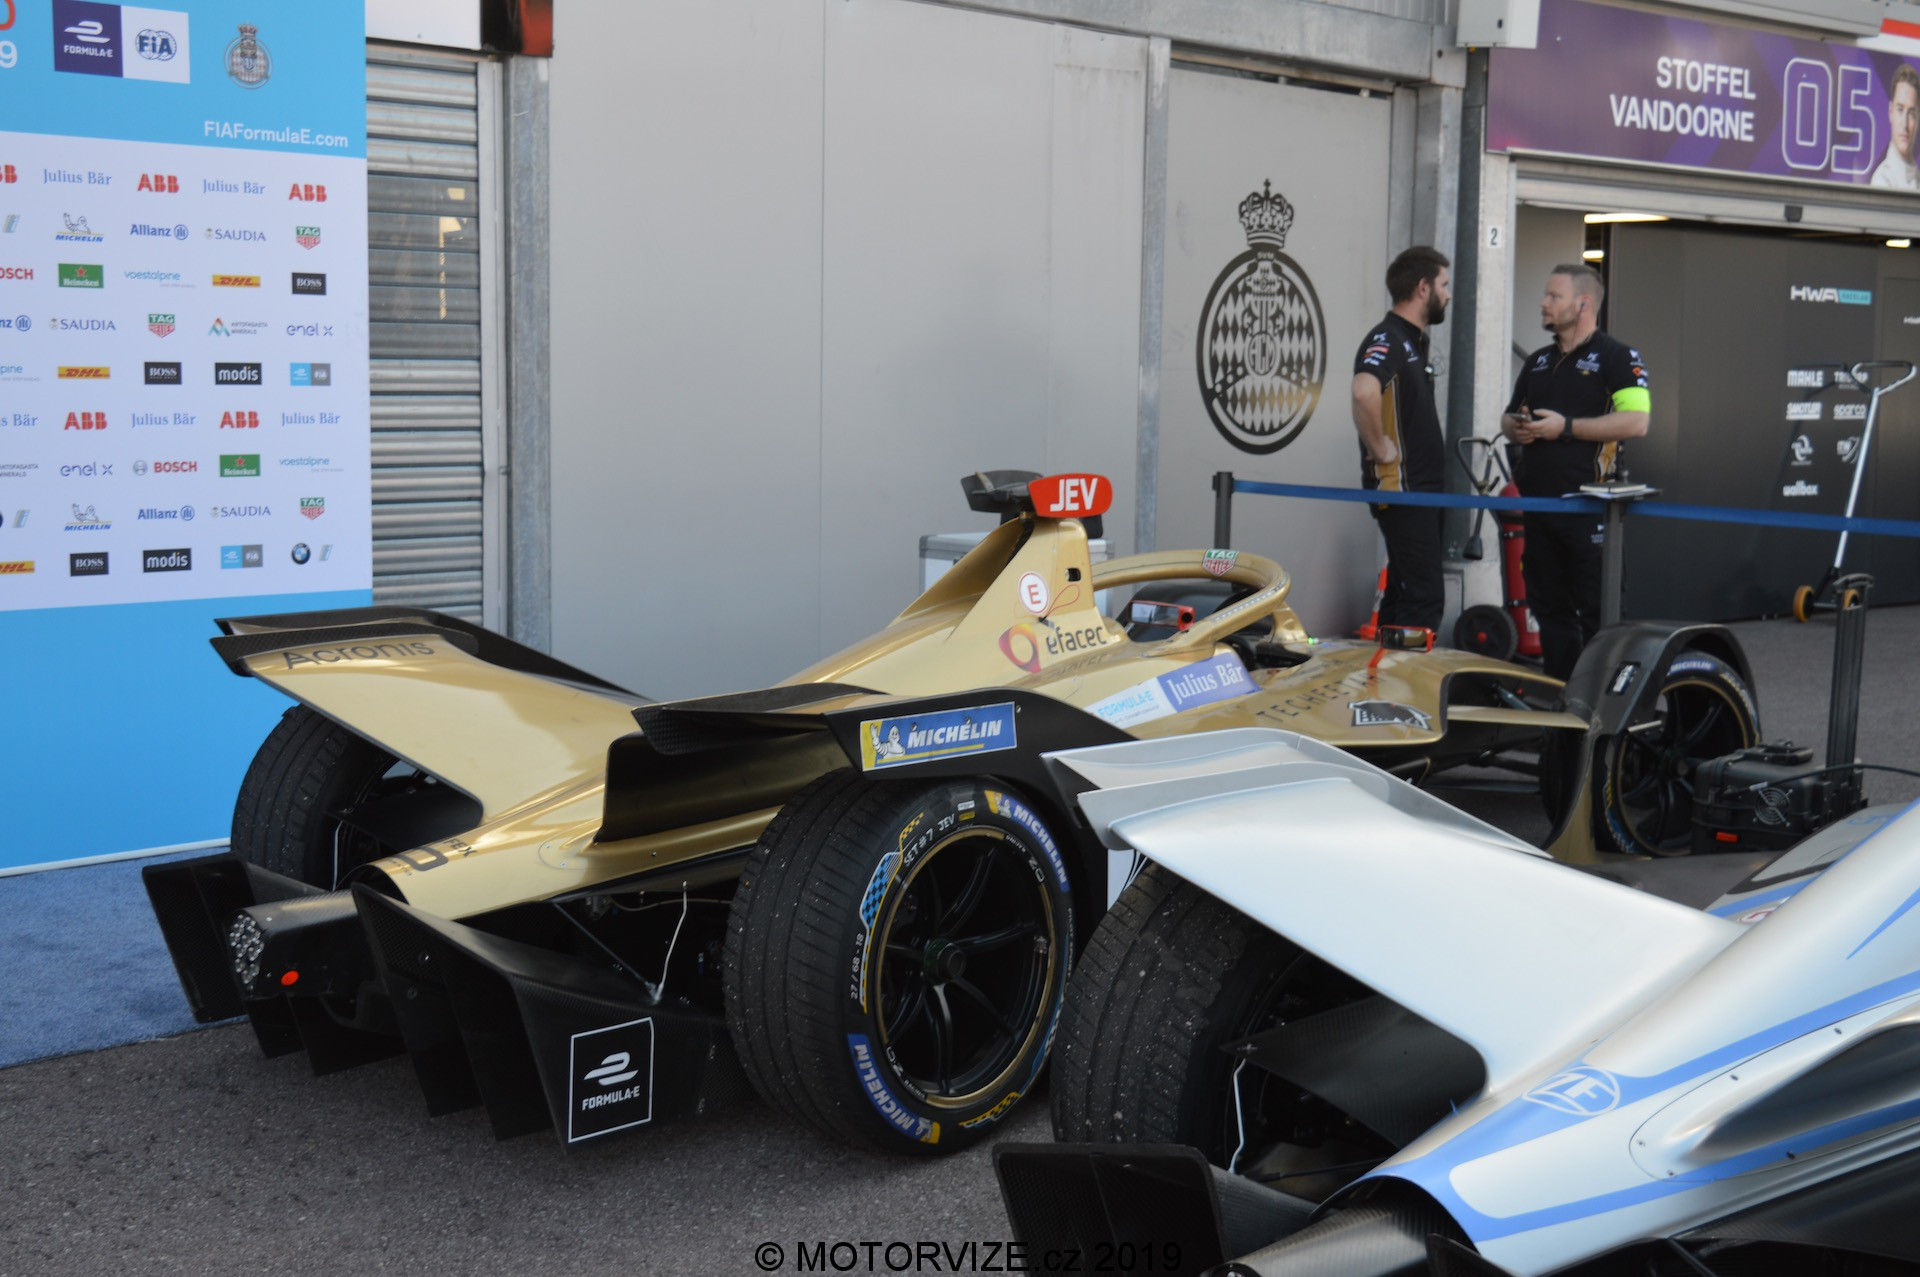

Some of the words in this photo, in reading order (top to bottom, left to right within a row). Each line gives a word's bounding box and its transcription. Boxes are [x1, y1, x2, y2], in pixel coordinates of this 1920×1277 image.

[1656, 56, 1756, 100] STOFFEL
[1609, 94, 1754, 143] VANDOORNE
[1781, 56, 1877, 176] 05
[204, 121, 349, 148] FIAFormulaE.com
[43, 168, 84, 185] Julius
[87, 171, 113, 186] Bär
[138, 173, 180, 194] ABB
[202, 178, 240, 194] Julius
[243, 180, 266, 195] Bär
[289, 183, 328, 203] ABB
[55, 234, 104, 243] MICHELIN
[130, 224, 172, 238] Allianz
[214, 228, 267, 242] SAUDIA
[297, 227, 321, 237] TAG
[1490, 227, 1498, 246] 2
[63, 277, 100, 288] Heineken
[124, 269, 182, 282] voestalpine
[217, 276, 255, 288] DHL
[296, 277, 323, 288] BOSS
[1790, 285, 1839, 303] HWA
[60, 319, 116, 331] SAUDIA
[150, 314, 175, 324] TAG
[286, 323, 319, 337] enel
[323, 327, 334, 337] x
[65, 368, 103, 378] DHL
[149, 366, 178, 377] BOSS
[218, 365, 260, 382] modis
[1787, 370, 1824, 387] MAHLE
[13, 413, 39, 428] Bär
[64, 411, 108, 431] ABB
[131, 413, 169, 428] Julius
[172, 412, 196, 426] Bär
[219, 411, 260, 429] ABB
[281, 412, 316, 427] Julius
[319, 412, 341, 425] Bär
[60, 461, 98, 477] enel
[102, 464, 113, 476] x
[154, 461, 198, 474] BOSCH
[279, 456, 331, 468] voestalpine
[223, 467, 257, 476] Heineken
[301, 497, 324, 507] TAG
[1050, 478, 1098, 512] JEV
[137, 508, 178, 520] Allianz
[221, 506, 271, 518] SAUDIA
[64, 524, 112, 532] MICHELIN
[146, 552, 188, 569] modis
[1207, 550, 1237, 560] TAG
[75, 558, 104, 569] BOSS
[1027, 584, 1042, 605] E
[1046, 626, 1107, 655] efacec
[282, 642, 435, 670] Acronis
[1166, 672, 1218, 705] Julius
[1215, 662, 1245, 687] Bär
[907, 719, 1003, 749] MICHELIN
[937, 813, 956, 832] JEV
[1013, 804, 1068, 885] MICHELIN
[853, 1043, 916, 1131] MICHELIN
[581, 1084, 641, 1112] FORMULA-E
